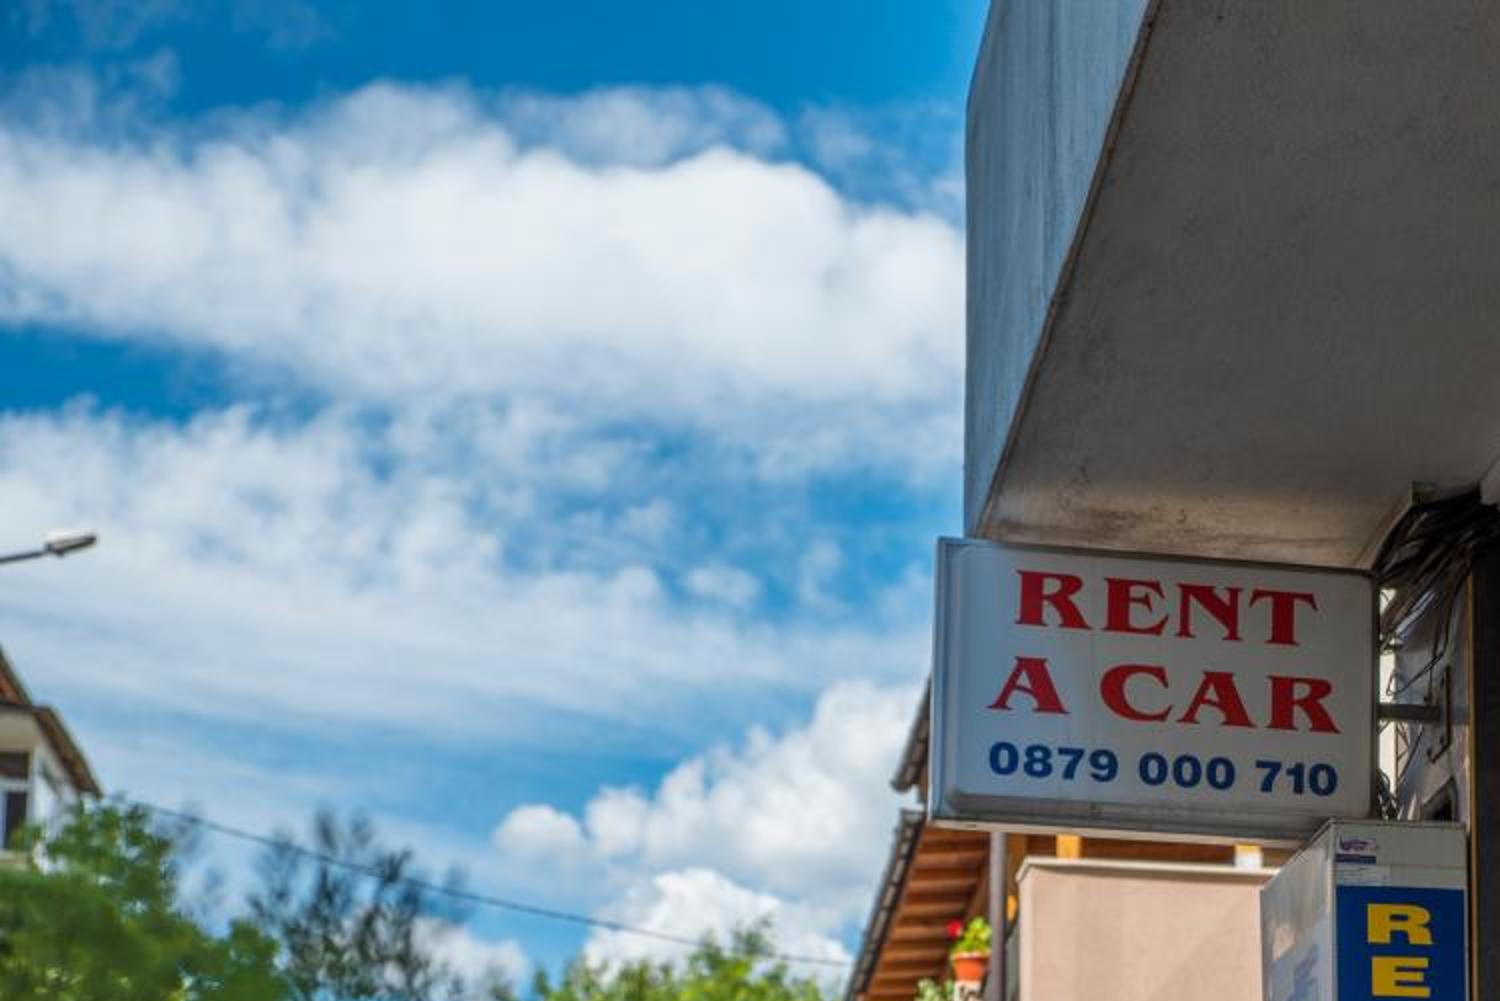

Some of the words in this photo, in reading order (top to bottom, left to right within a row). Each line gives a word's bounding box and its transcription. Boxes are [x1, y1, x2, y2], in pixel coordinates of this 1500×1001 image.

[1016, 569, 1317, 647] RENT
[987, 656, 1069, 716] A
[1100, 664, 1341, 734] CAR
[989, 741, 1119, 783] 0879
[1138, 752, 1236, 790] 000
[1255, 759, 1339, 796] 710
